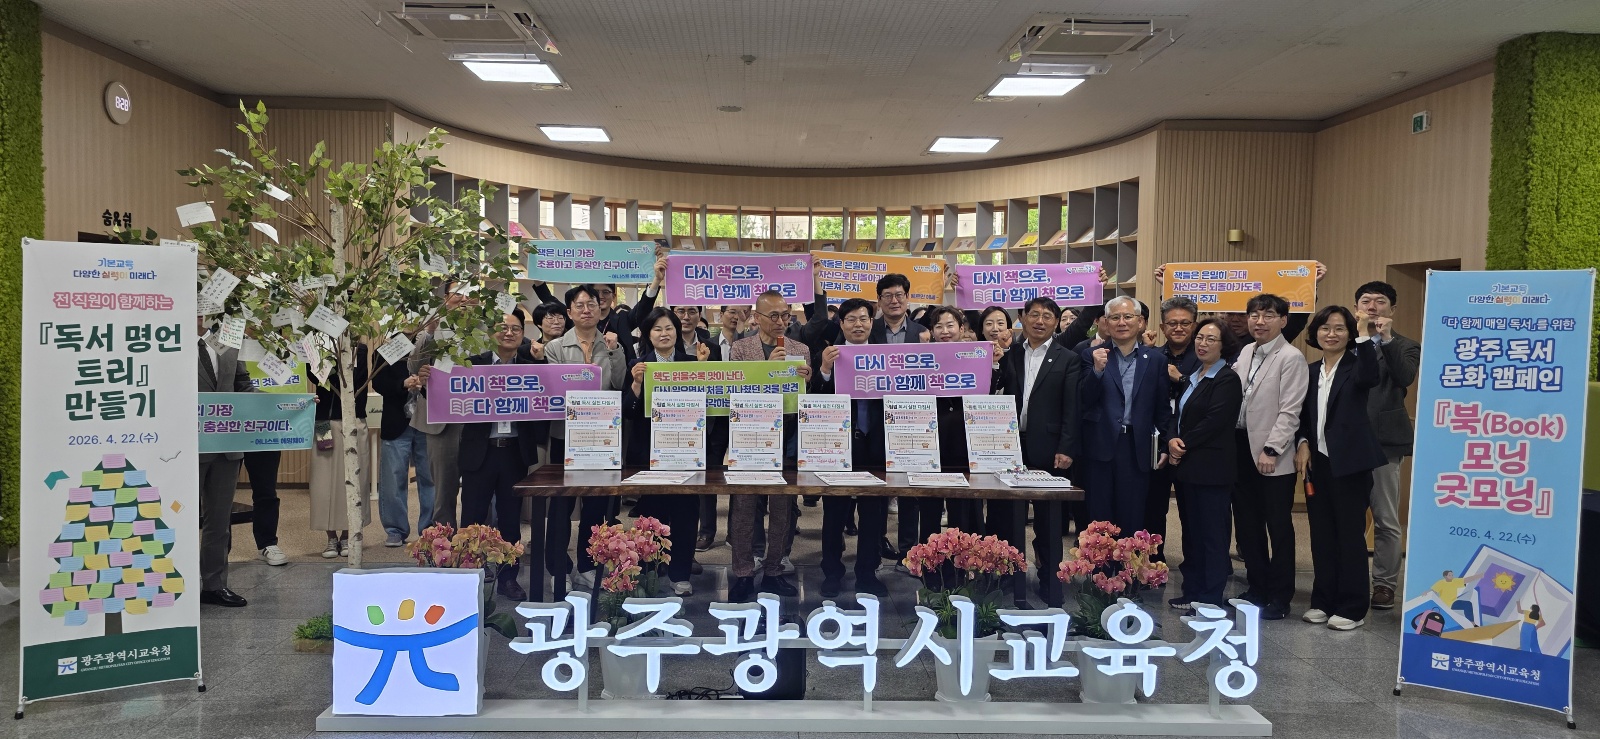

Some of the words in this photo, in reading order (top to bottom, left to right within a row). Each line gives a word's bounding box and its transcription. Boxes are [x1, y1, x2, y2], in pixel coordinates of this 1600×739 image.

[115, 95, 129, 111] 8:28
[557, 249, 574, 257] 나의
[577, 249, 595, 257] 가장
[98, 258, 134, 270] 기본교육
[537, 260, 572, 269] 조용하고
[575, 260, 601, 269] 충실한
[603, 260, 640, 269] 친구이다.
[844, 260, 869, 270] 은밀히
[870, 262, 887, 271] 그대
[73, 269, 100, 279] 다양한
[102, 270, 128, 281] 실력이
[130, 270, 157, 280] 미래다
[685, 265, 713, 280] 다시
[717, 264, 764, 281] 책으로,
[819, 270, 850, 280] 자산으로
[973, 271, 1001, 285] 다시
[1004, 269, 1051, 284] 책으로,
[1174, 271, 1199, 279] 책들은
[1201, 271, 1227, 279] 은밀히
[1229, 271, 1247, 279] 그대
[704, 284, 719, 299] 다
[722, 284, 751, 299] 함께
[753, 283, 797, 297] 책으로
[844, 284, 862, 292] 주지.
[992, 289, 1006, 303] 다
[1009, 288, 1038, 302] 함께
[1041, 285, 1085, 300] 책으로
[1173, 282, 1206, 291] 자산으로
[1209, 282, 1261, 291] 되돌아가도록
[1492, 283, 1528, 295] 기본교육
[54, 293, 70, 308] 전
[73, 293, 116, 309] 직원이
[118, 294, 173, 310] 함께하는
[1200, 294, 1219, 303] 주지.
[1469, 295, 1494, 304] 다양한
[1495, 296, 1521, 306] 실력이
[1522, 294, 1550, 304] 미래다
[1461, 317, 1482, 329] 함께
[1485, 318, 1507, 330] 매일
[1551, 319, 1574, 331] 위한
[40, 322, 113, 352] 『독서
[125, 323, 181, 352] 명언
[1456, 338, 1502, 361] 광주
[1507, 339, 1555, 362] 독서
[855, 354, 885, 371] 다시
[888, 353, 940, 370] 책으로,
[75, 357, 148, 387] 트리』
[653, 372, 670, 381] 책도
[672, 371, 705, 381] 읽을수록
[708, 371, 724, 381] 맛이
[726, 371, 745, 381] 난다.
[1441, 365, 1487, 388] 문화
[1492, 366, 1562, 391] 캠페인
[450, 376, 485, 393] 다시
[489, 375, 544, 393] 책으로,
[706, 385, 724, 395] 처음
[726, 384, 760, 394] 지나쳤던
[763, 384, 779, 394] 것을
[782, 383, 798, 393] 발견
[876, 376, 891, 391] 다
[894, 375, 925, 391] 함께
[929, 374, 976, 389] 책으로
[65, 389, 156, 421] 만들기
[208, 404, 233, 417] 가장
[473, 399, 491, 414] 다
[495, 397, 529, 414] 함께
[533, 396, 566, 412] 책으
[204, 421, 241, 433] 충실한
[244, 420, 293, 432] 친구이다.
[68, 435, 102, 445] 2026.
[106, 435, 117, 444] 4.
[121, 432, 158, 445] 22.(수)
[1462, 442, 1527, 475] 모닝
[1436, 474, 1551, 516] 굿모닝』
[1449, 526, 1480, 539] 2026.
[1484, 530, 1494, 540] 4.
[1499, 532, 1536, 545] 22.(수)
[508, 594, 1260, 698] 광주광역시교육청
[81, 645, 171, 666] 광주광역시교육청
[1453, 657, 1541, 681] 광주광역시교육청
